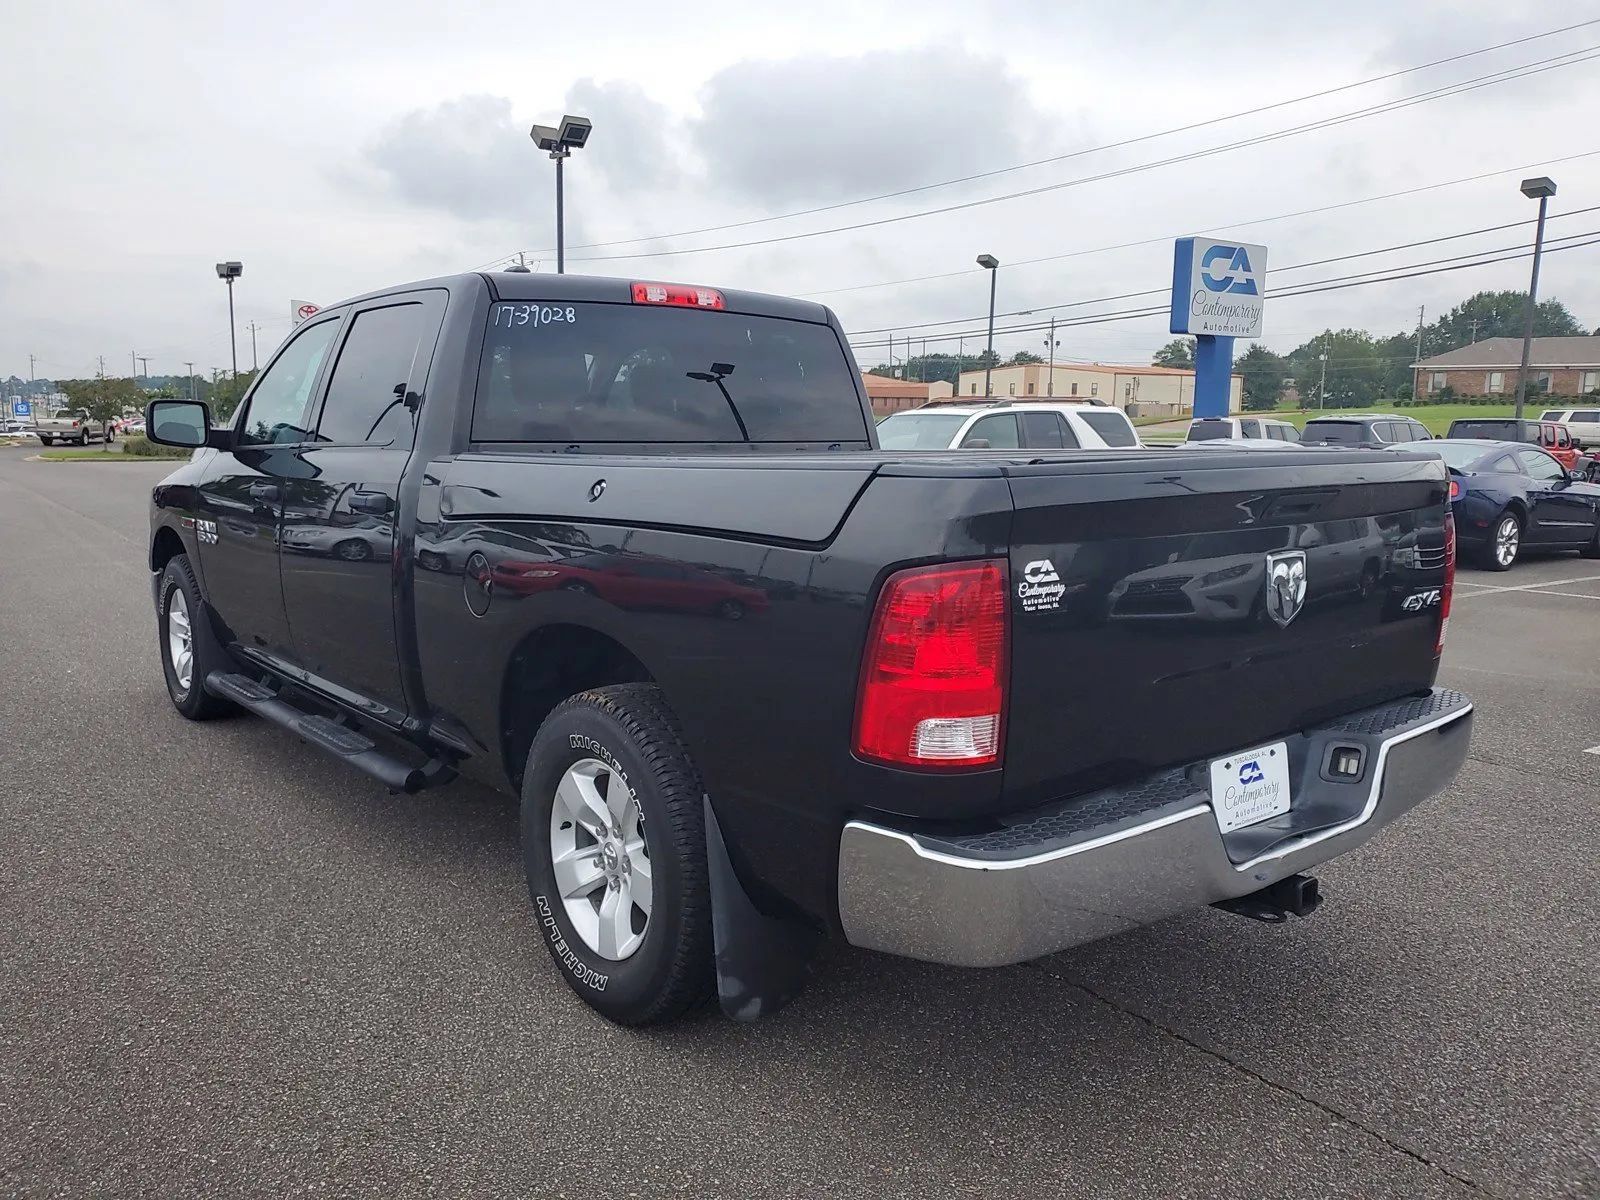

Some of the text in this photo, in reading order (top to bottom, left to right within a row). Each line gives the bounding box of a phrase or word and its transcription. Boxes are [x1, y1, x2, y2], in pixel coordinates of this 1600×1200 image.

[1201, 244, 1259, 296] CA
[494, 304, 576, 328] 17-39028
[1191, 289, 1261, 329] Contemporary
[1203, 321, 1250, 334] Automotive
[1024, 559, 1060, 583] CA
[1018, 582, 1066, 599] Contemporary
[1022, 596, 1060, 606] Automotive
[569, 734, 646, 822] MICHELIN
[1239, 761, 1265, 785] CA
[1224, 781, 1280, 810] Contemporary
[1235, 801, 1273, 819] Automotive
[537, 896, 609, 992] MICHELIN
